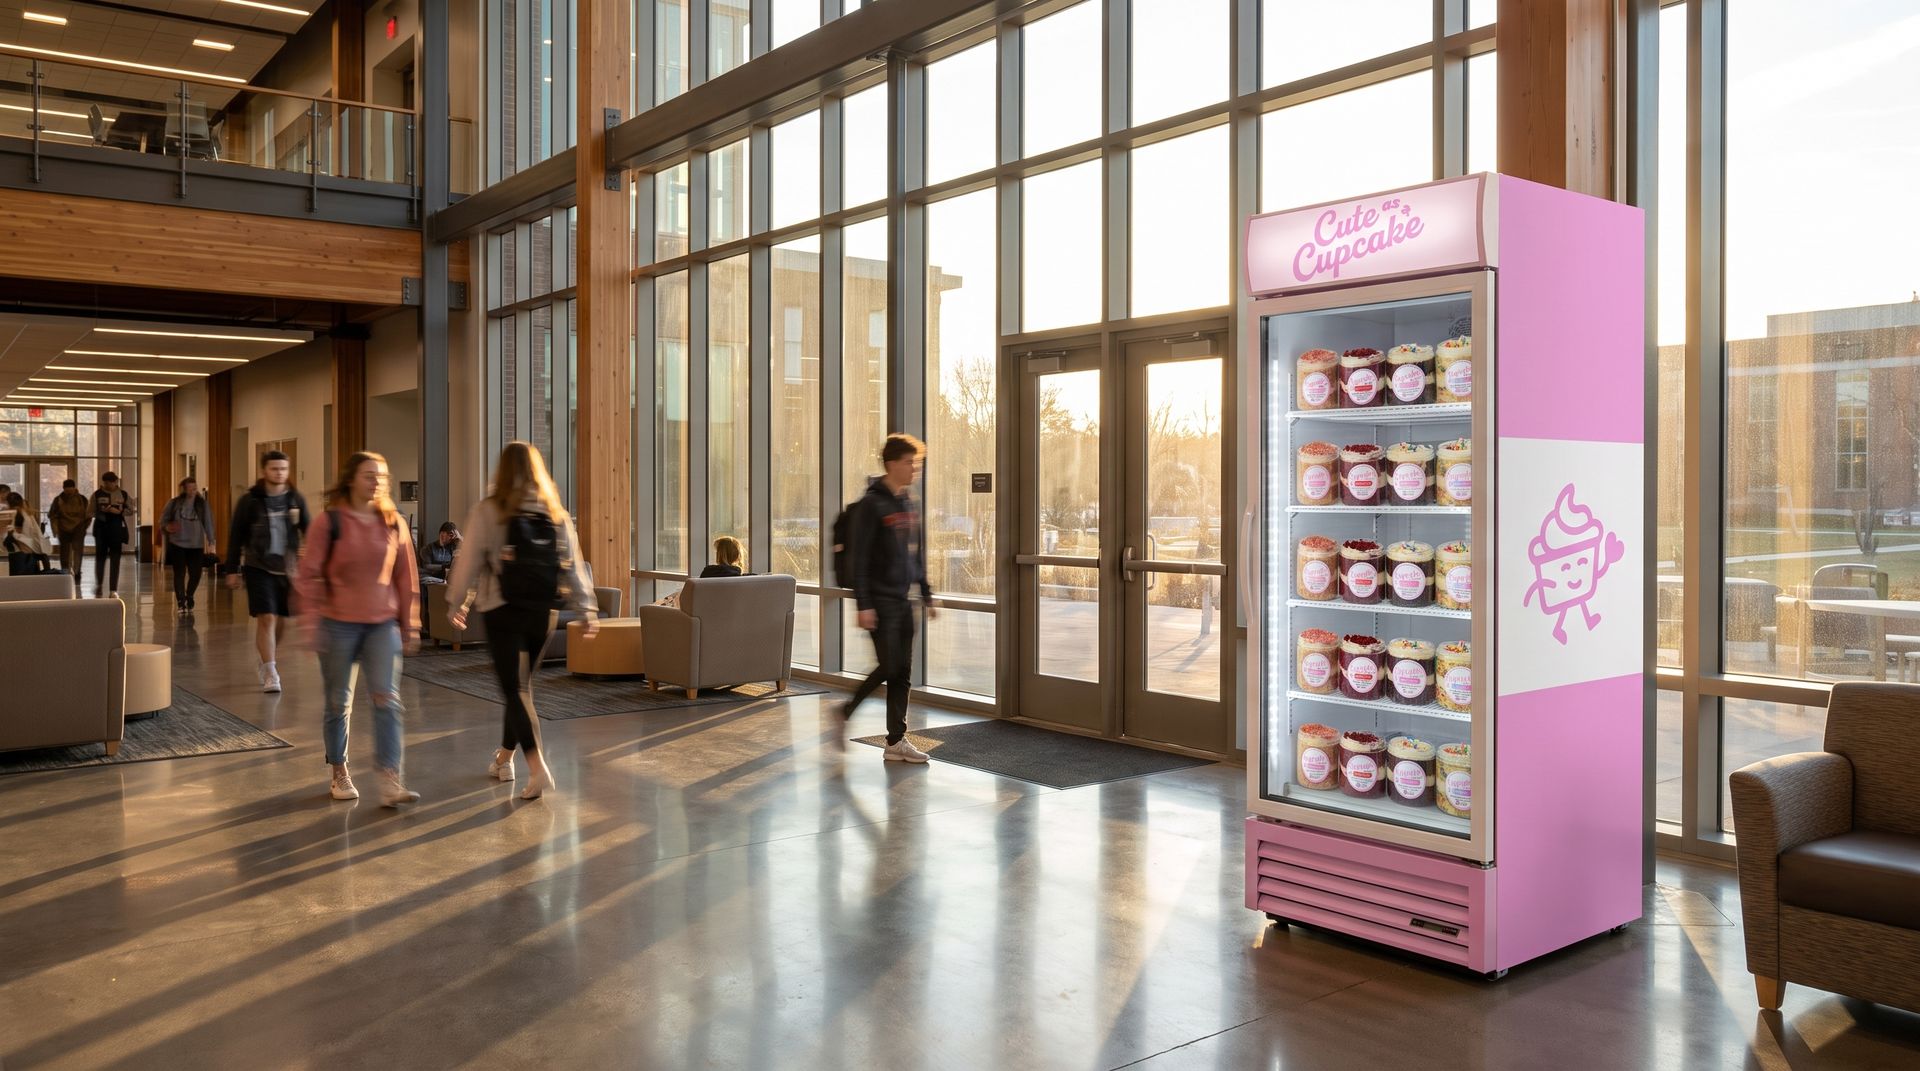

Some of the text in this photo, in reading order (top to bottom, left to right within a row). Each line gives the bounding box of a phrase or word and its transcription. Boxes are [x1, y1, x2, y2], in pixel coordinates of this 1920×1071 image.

[1292, 213, 1425, 282] Cupcake
[1314, 204, 1380, 247] Cute
[1382, 199, 1400, 212] as
